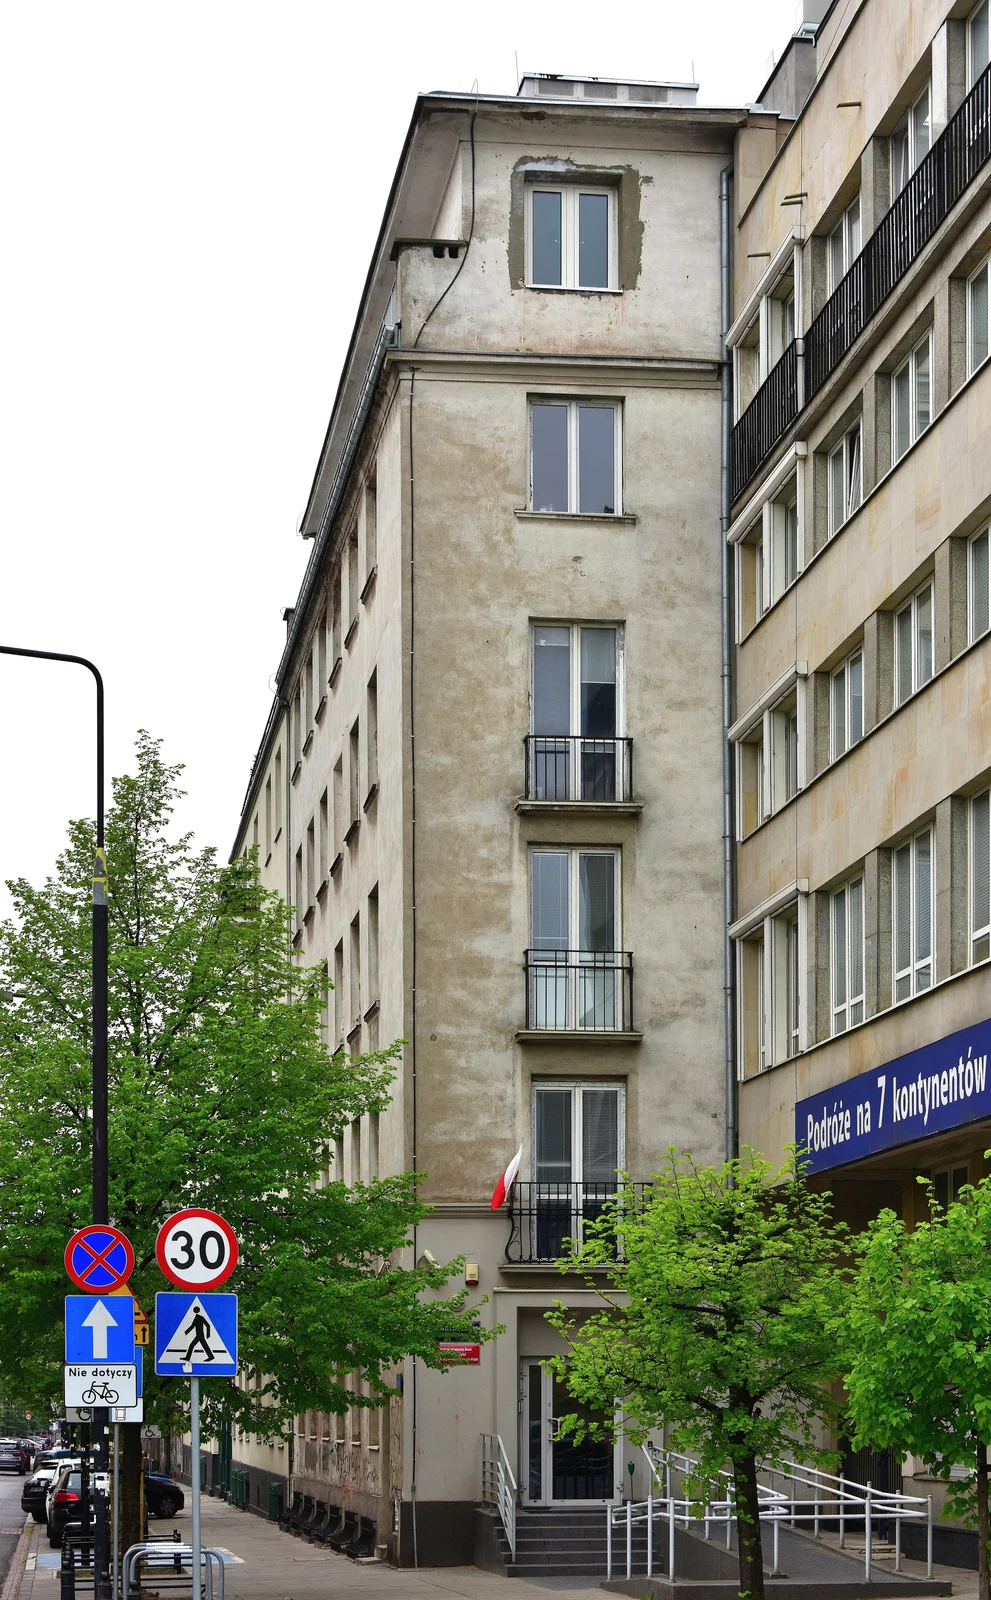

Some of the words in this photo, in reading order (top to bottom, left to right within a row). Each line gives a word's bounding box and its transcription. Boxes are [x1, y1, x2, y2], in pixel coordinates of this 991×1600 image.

[807, 1099, 851, 1154] Podróże
[856, 1100, 871, 1137] na
[877, 1075, 886, 1129] 7
[893, 1046, 987, 1126] kontynentów
[170, 1230, 226, 1270] 30
[69, 1367, 87, 1377] Nie
[91, 1367, 132, 1379] dotyczy
